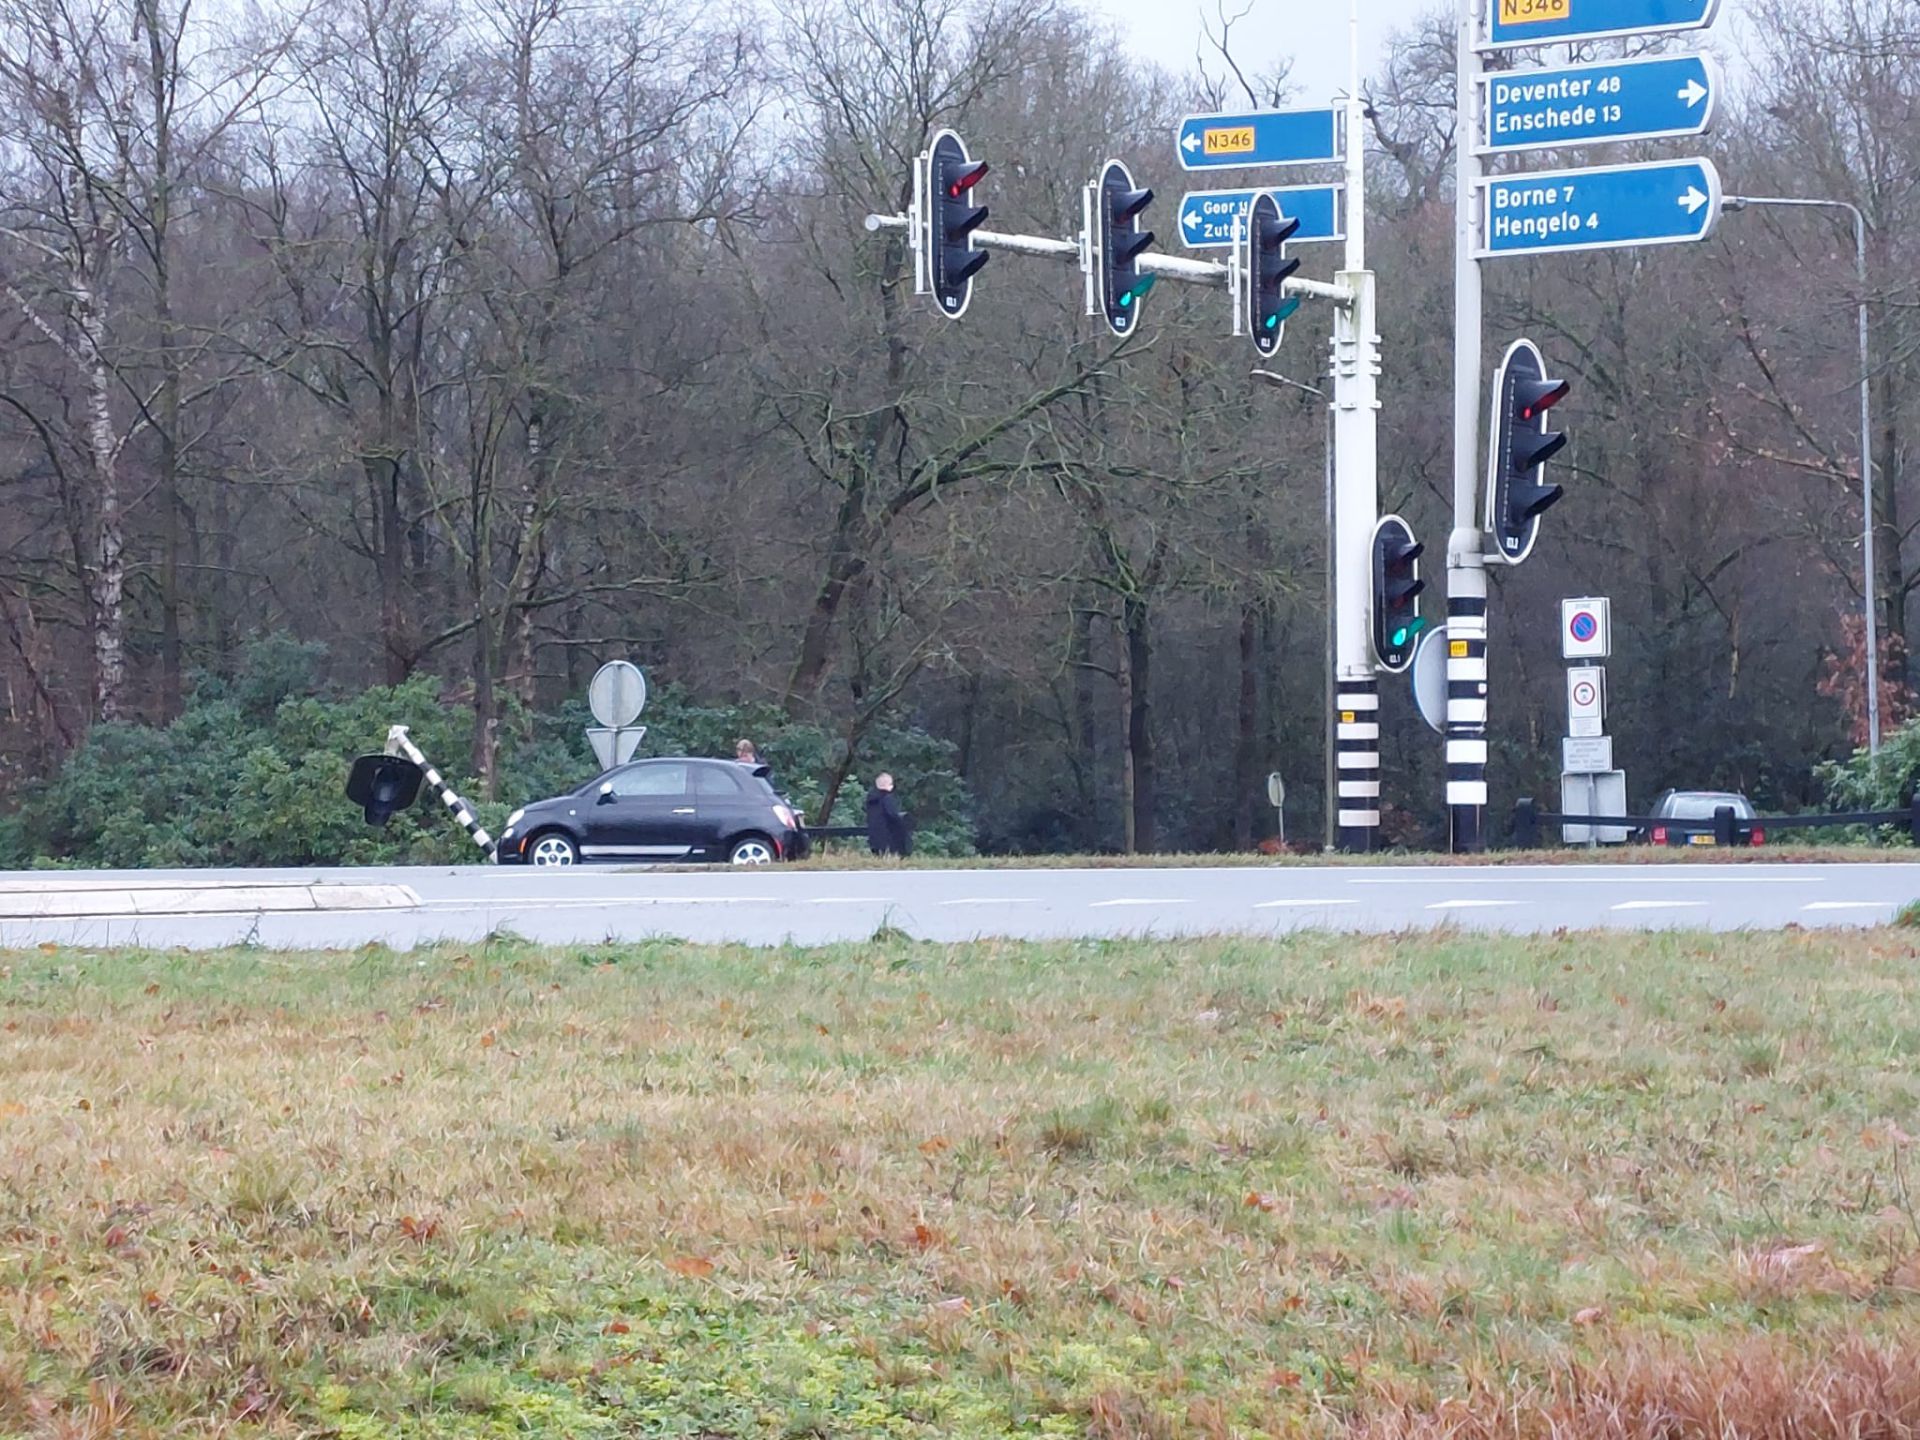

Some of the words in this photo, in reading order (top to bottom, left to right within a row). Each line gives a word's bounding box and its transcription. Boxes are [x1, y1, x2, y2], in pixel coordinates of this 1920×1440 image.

[1496, 78, 1592, 105] Deventer
[1596, 76, 1621, 94] 48
[1496, 104, 1597, 133] Enschede
[1602, 105, 1621, 123] 13
[1208, 133, 1251, 148] N346
[1203, 201, 1236, 215] Goor
[1495, 188, 1558, 209] Borne
[1562, 186, 1575, 203] 7
[1495, 210, 1580, 239] Hengelo
[1586, 212, 1599, 230] 4
